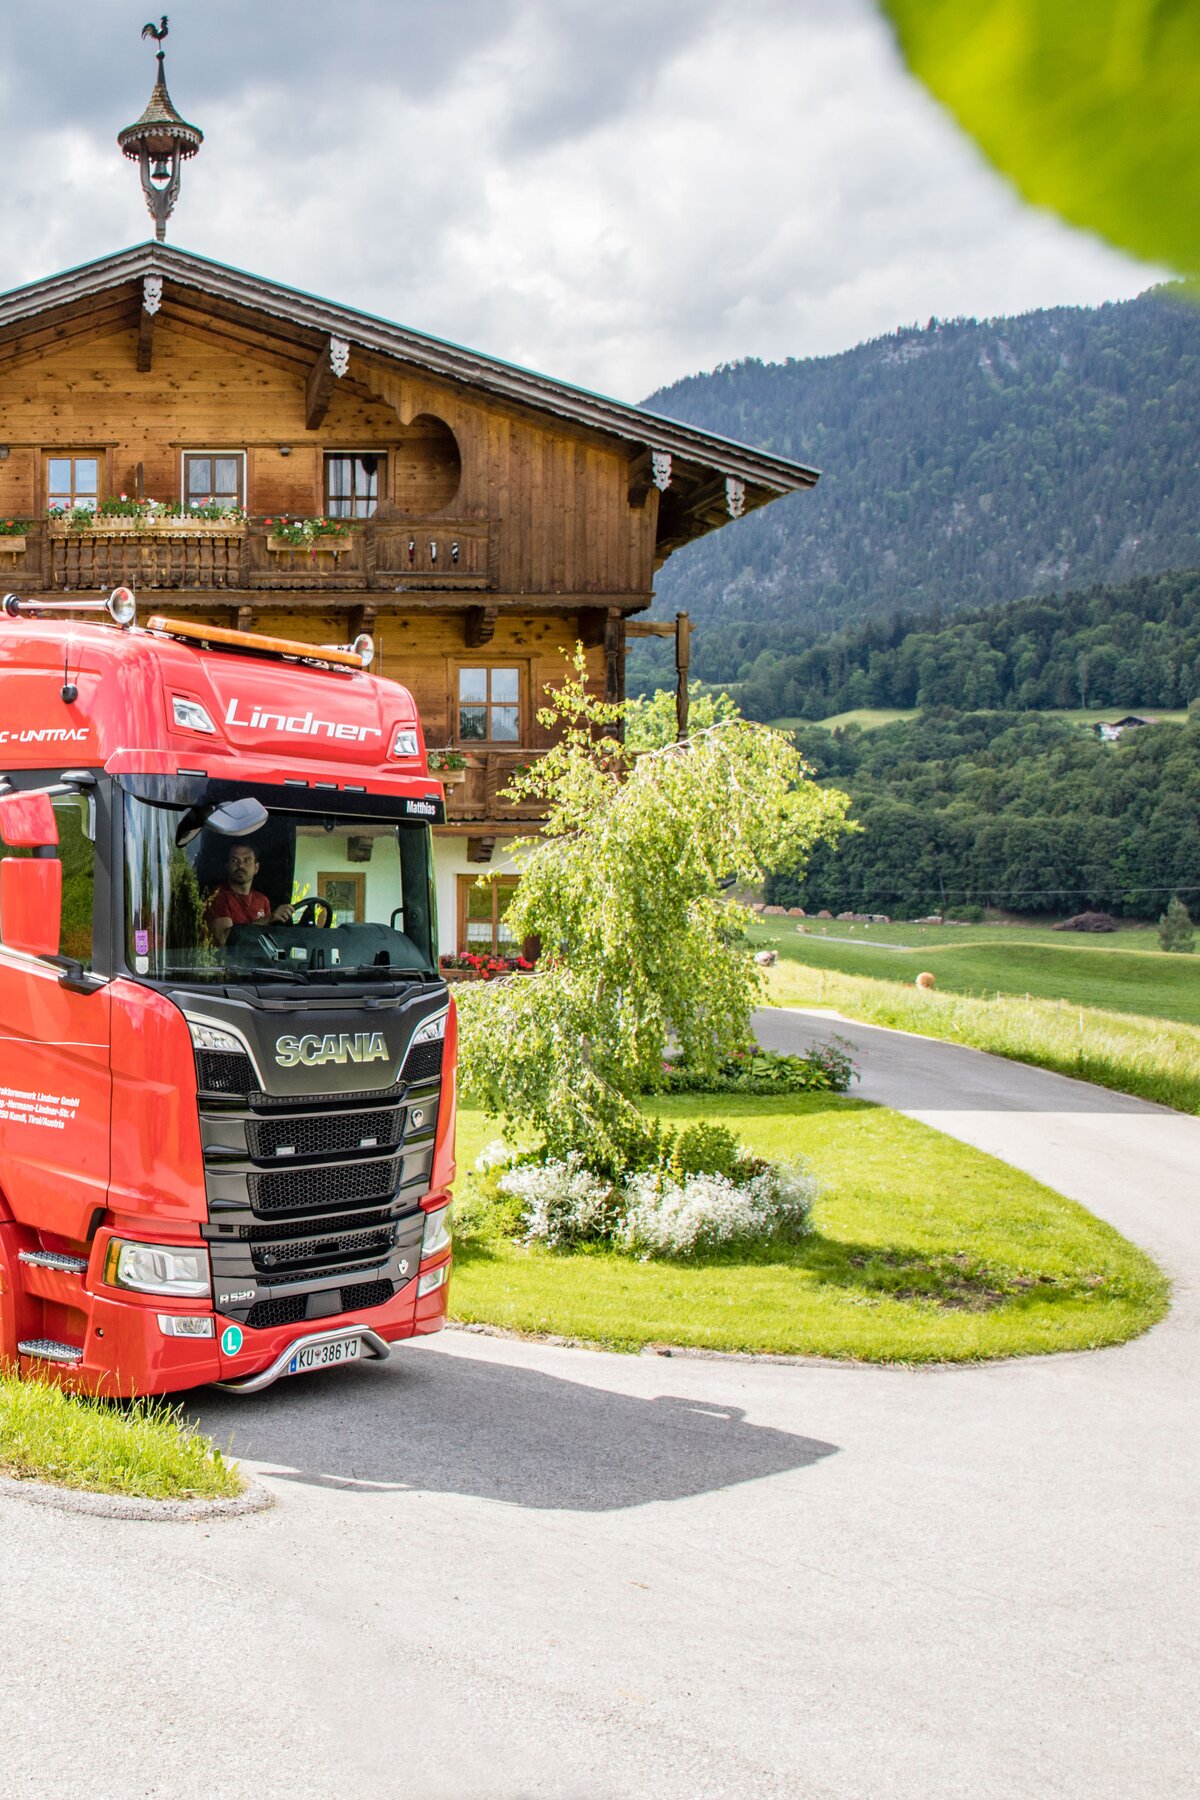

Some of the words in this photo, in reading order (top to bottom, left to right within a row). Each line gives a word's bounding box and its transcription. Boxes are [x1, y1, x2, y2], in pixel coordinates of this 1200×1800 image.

[224, 698, 382, 742] Lindner
[19, 728, 90, 742] UNITRAC
[406, 800, 436, 815] Matthias
[275, 1032, 390, 1067] SCANIA
[37, 1092, 60, 1104] Lindner
[60, 1096, 80, 1107] GmbH
[227, 1331, 237, 1351] L
[299, 1349, 314, 1368] KU
[321, 1343, 342, 1363] 386
[344, 1340, 357, 1358] YJ
